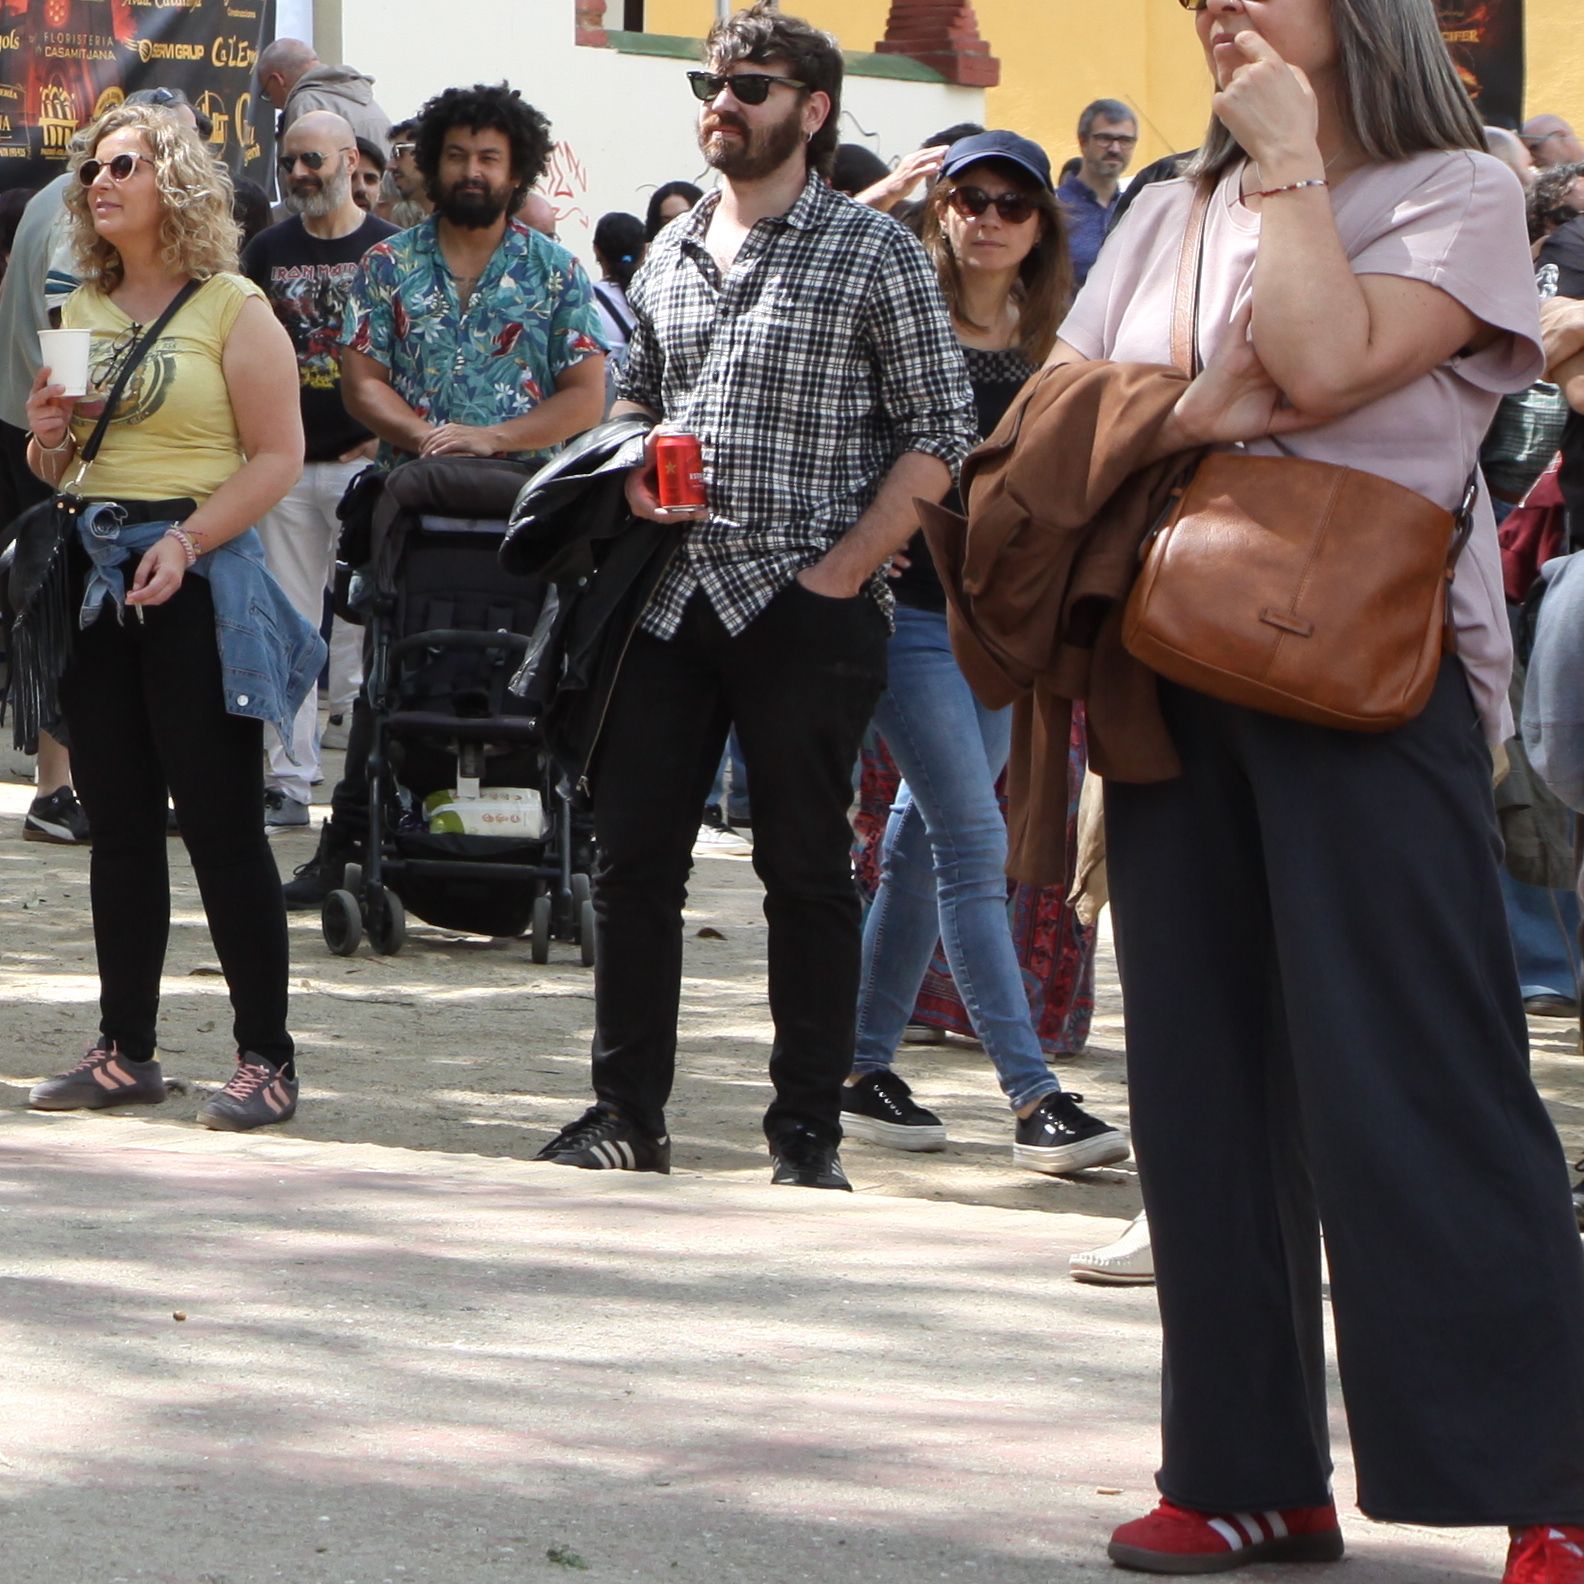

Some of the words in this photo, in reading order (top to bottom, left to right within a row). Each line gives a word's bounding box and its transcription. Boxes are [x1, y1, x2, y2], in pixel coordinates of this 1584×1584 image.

[44, 32, 114, 49] FLORISTERIA
[44, 46, 117, 62] CASAMITJANA
[271, 266, 315, 282] IRON
[316, 262, 358, 279] MAID
